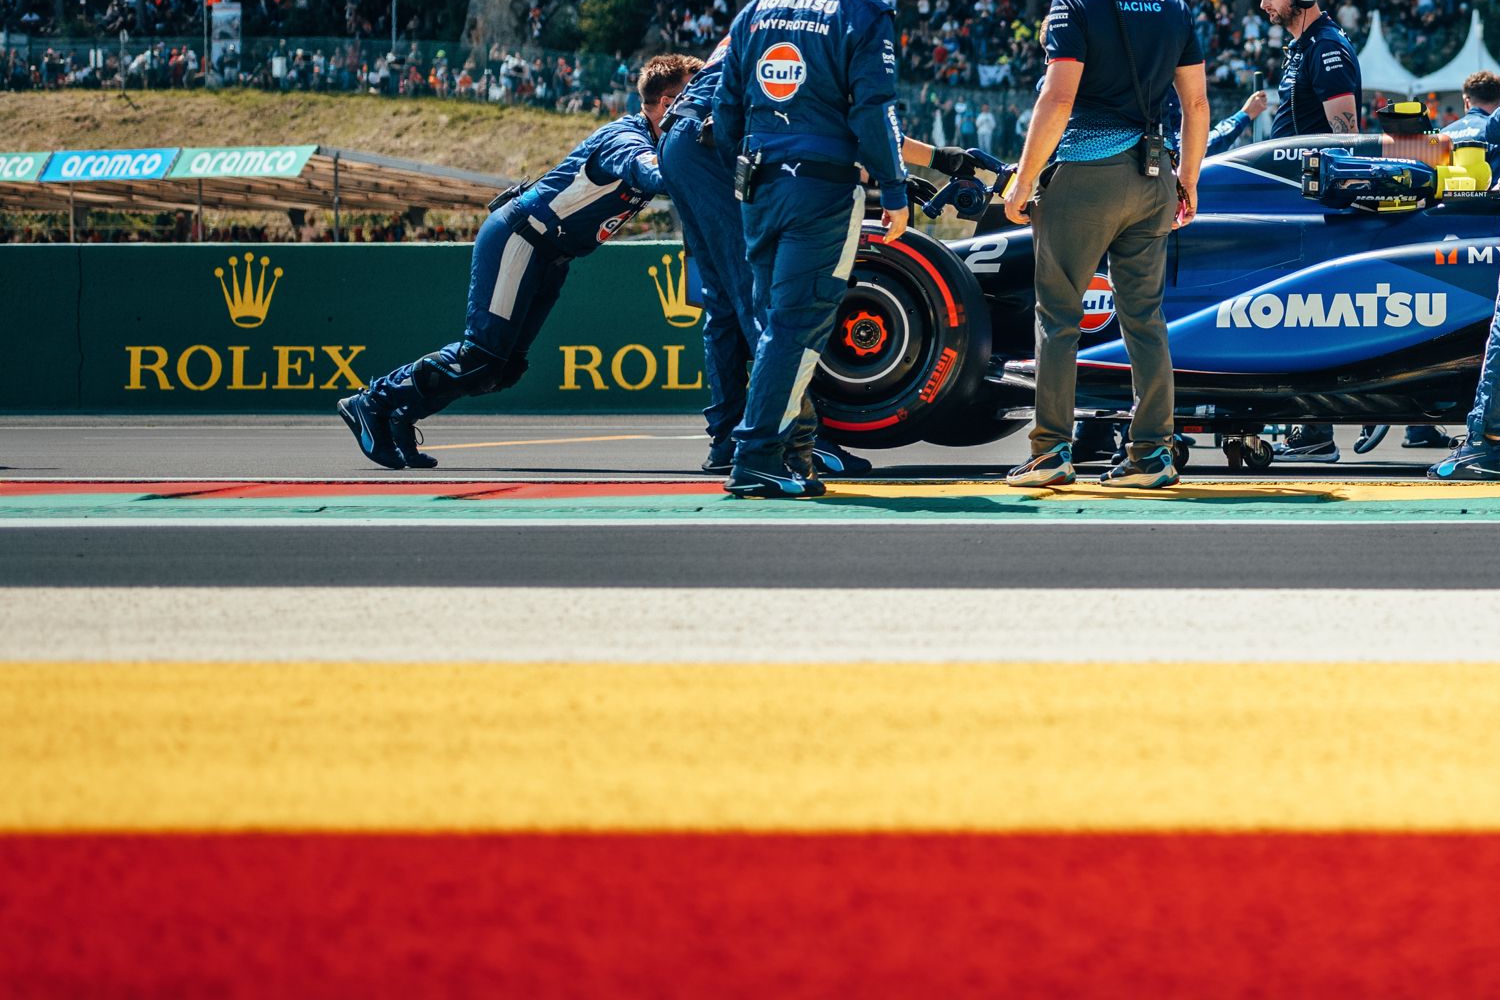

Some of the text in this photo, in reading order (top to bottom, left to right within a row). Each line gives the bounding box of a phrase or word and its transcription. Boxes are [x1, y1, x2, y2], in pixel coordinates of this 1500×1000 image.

[759, 20, 830, 35] MYPROTEIN
[761, 63, 803, 80] Gulf
[61, 153, 162, 177] aramco
[190, 151, 296, 174] aramco
[1083, 294, 1114, 310] ulf
[1216, 283, 1448, 329] KOMATSU
[125, 344, 369, 391] ROLEX
[559, 343, 711, 391] ROL
[919, 346, 958, 403] PIRELLI
